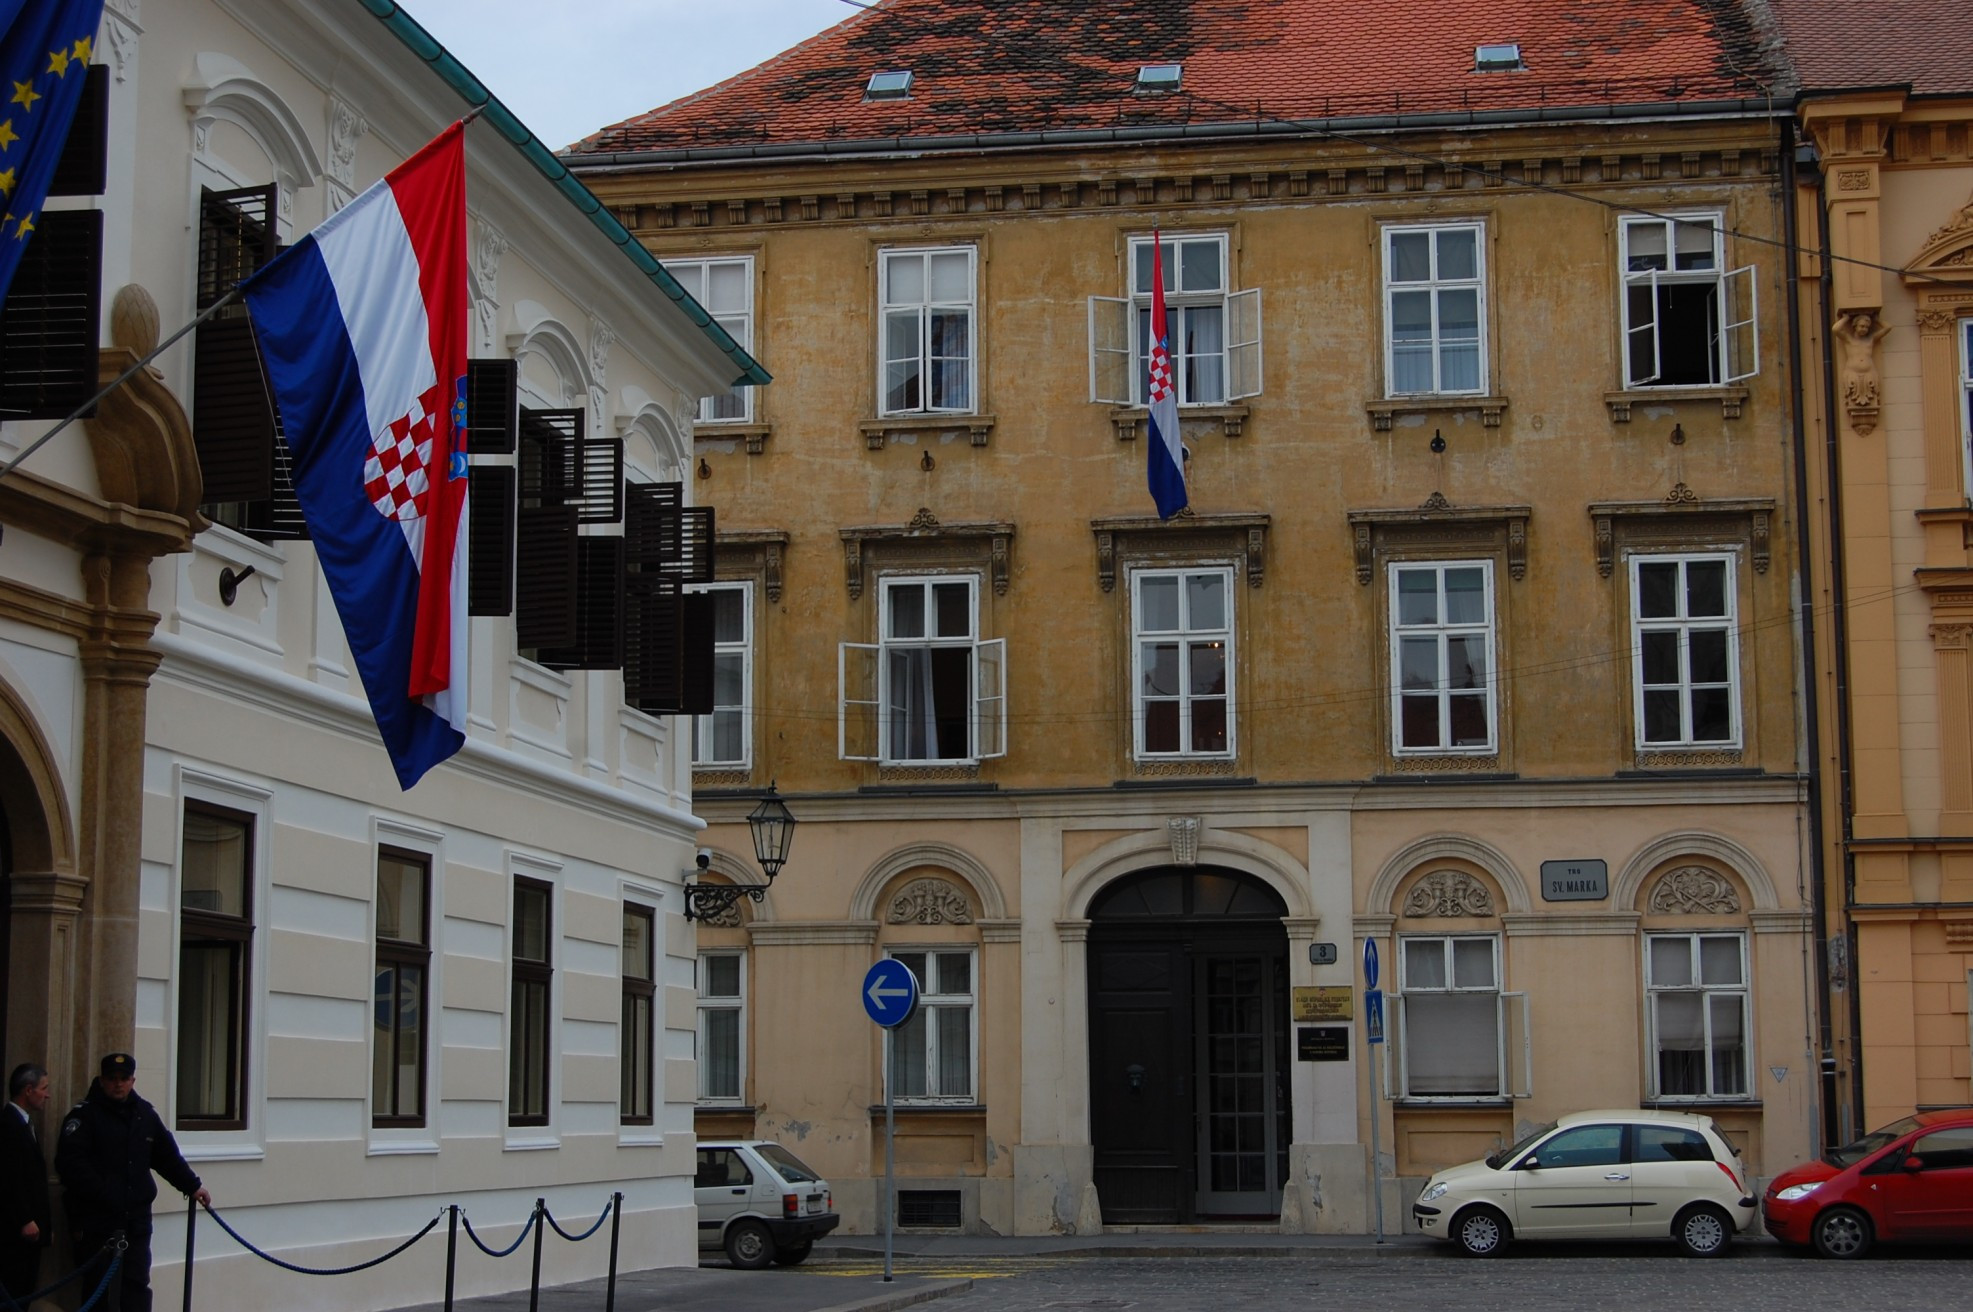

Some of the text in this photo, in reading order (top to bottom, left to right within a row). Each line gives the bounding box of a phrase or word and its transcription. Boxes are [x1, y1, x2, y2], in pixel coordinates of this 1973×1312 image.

[1552, 880, 1598, 893] SV. MARKA
[1320, 946, 1327, 957] 3
